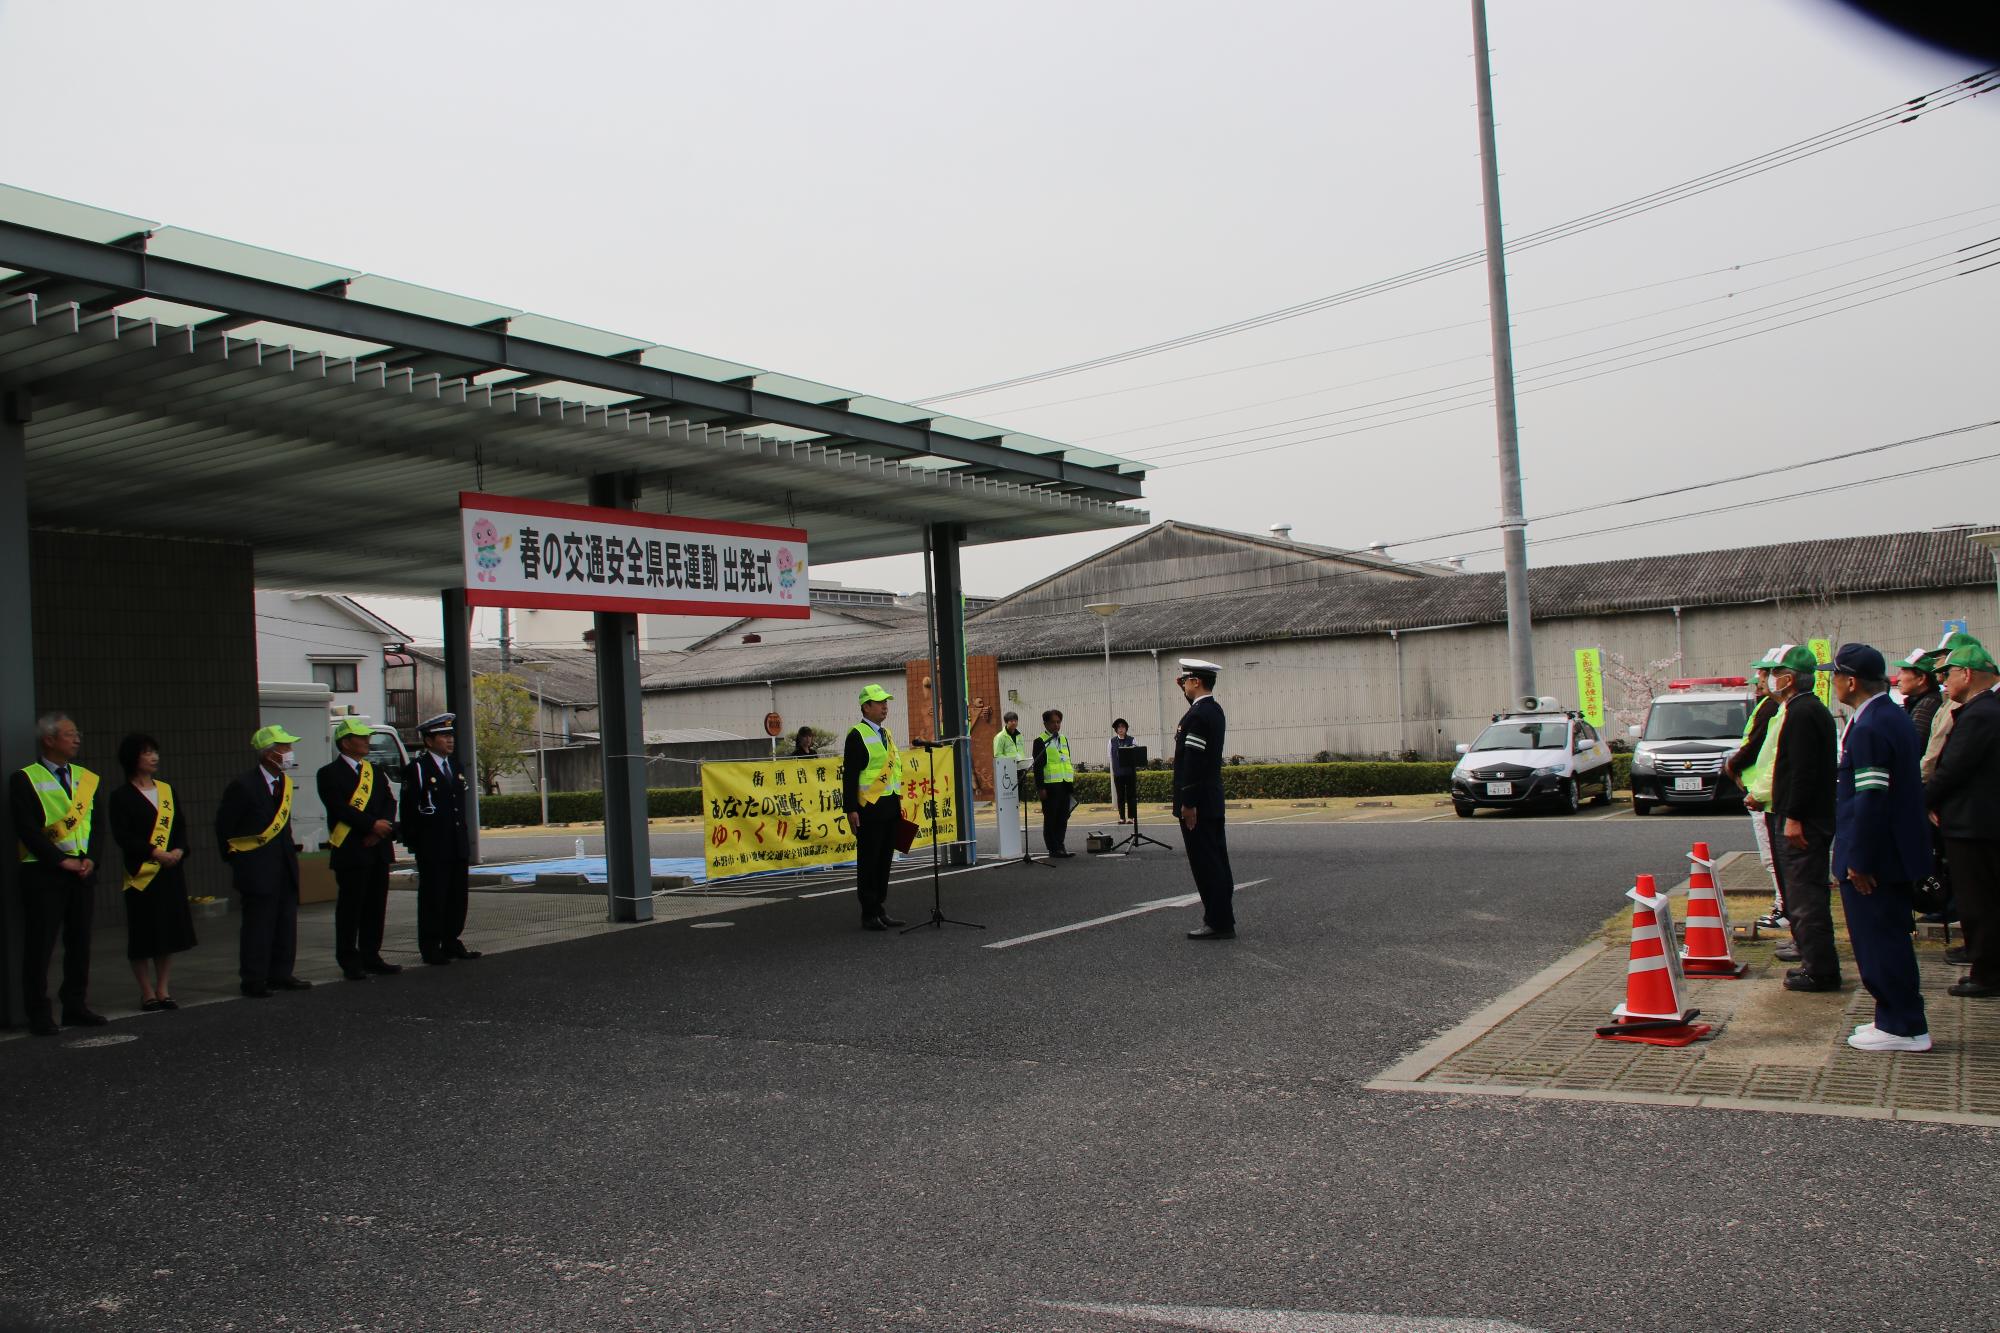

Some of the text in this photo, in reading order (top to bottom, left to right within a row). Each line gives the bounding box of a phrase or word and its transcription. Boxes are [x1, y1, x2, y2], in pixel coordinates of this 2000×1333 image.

[519, 527, 773, 594] 春の交通安全県民運動 出発式
